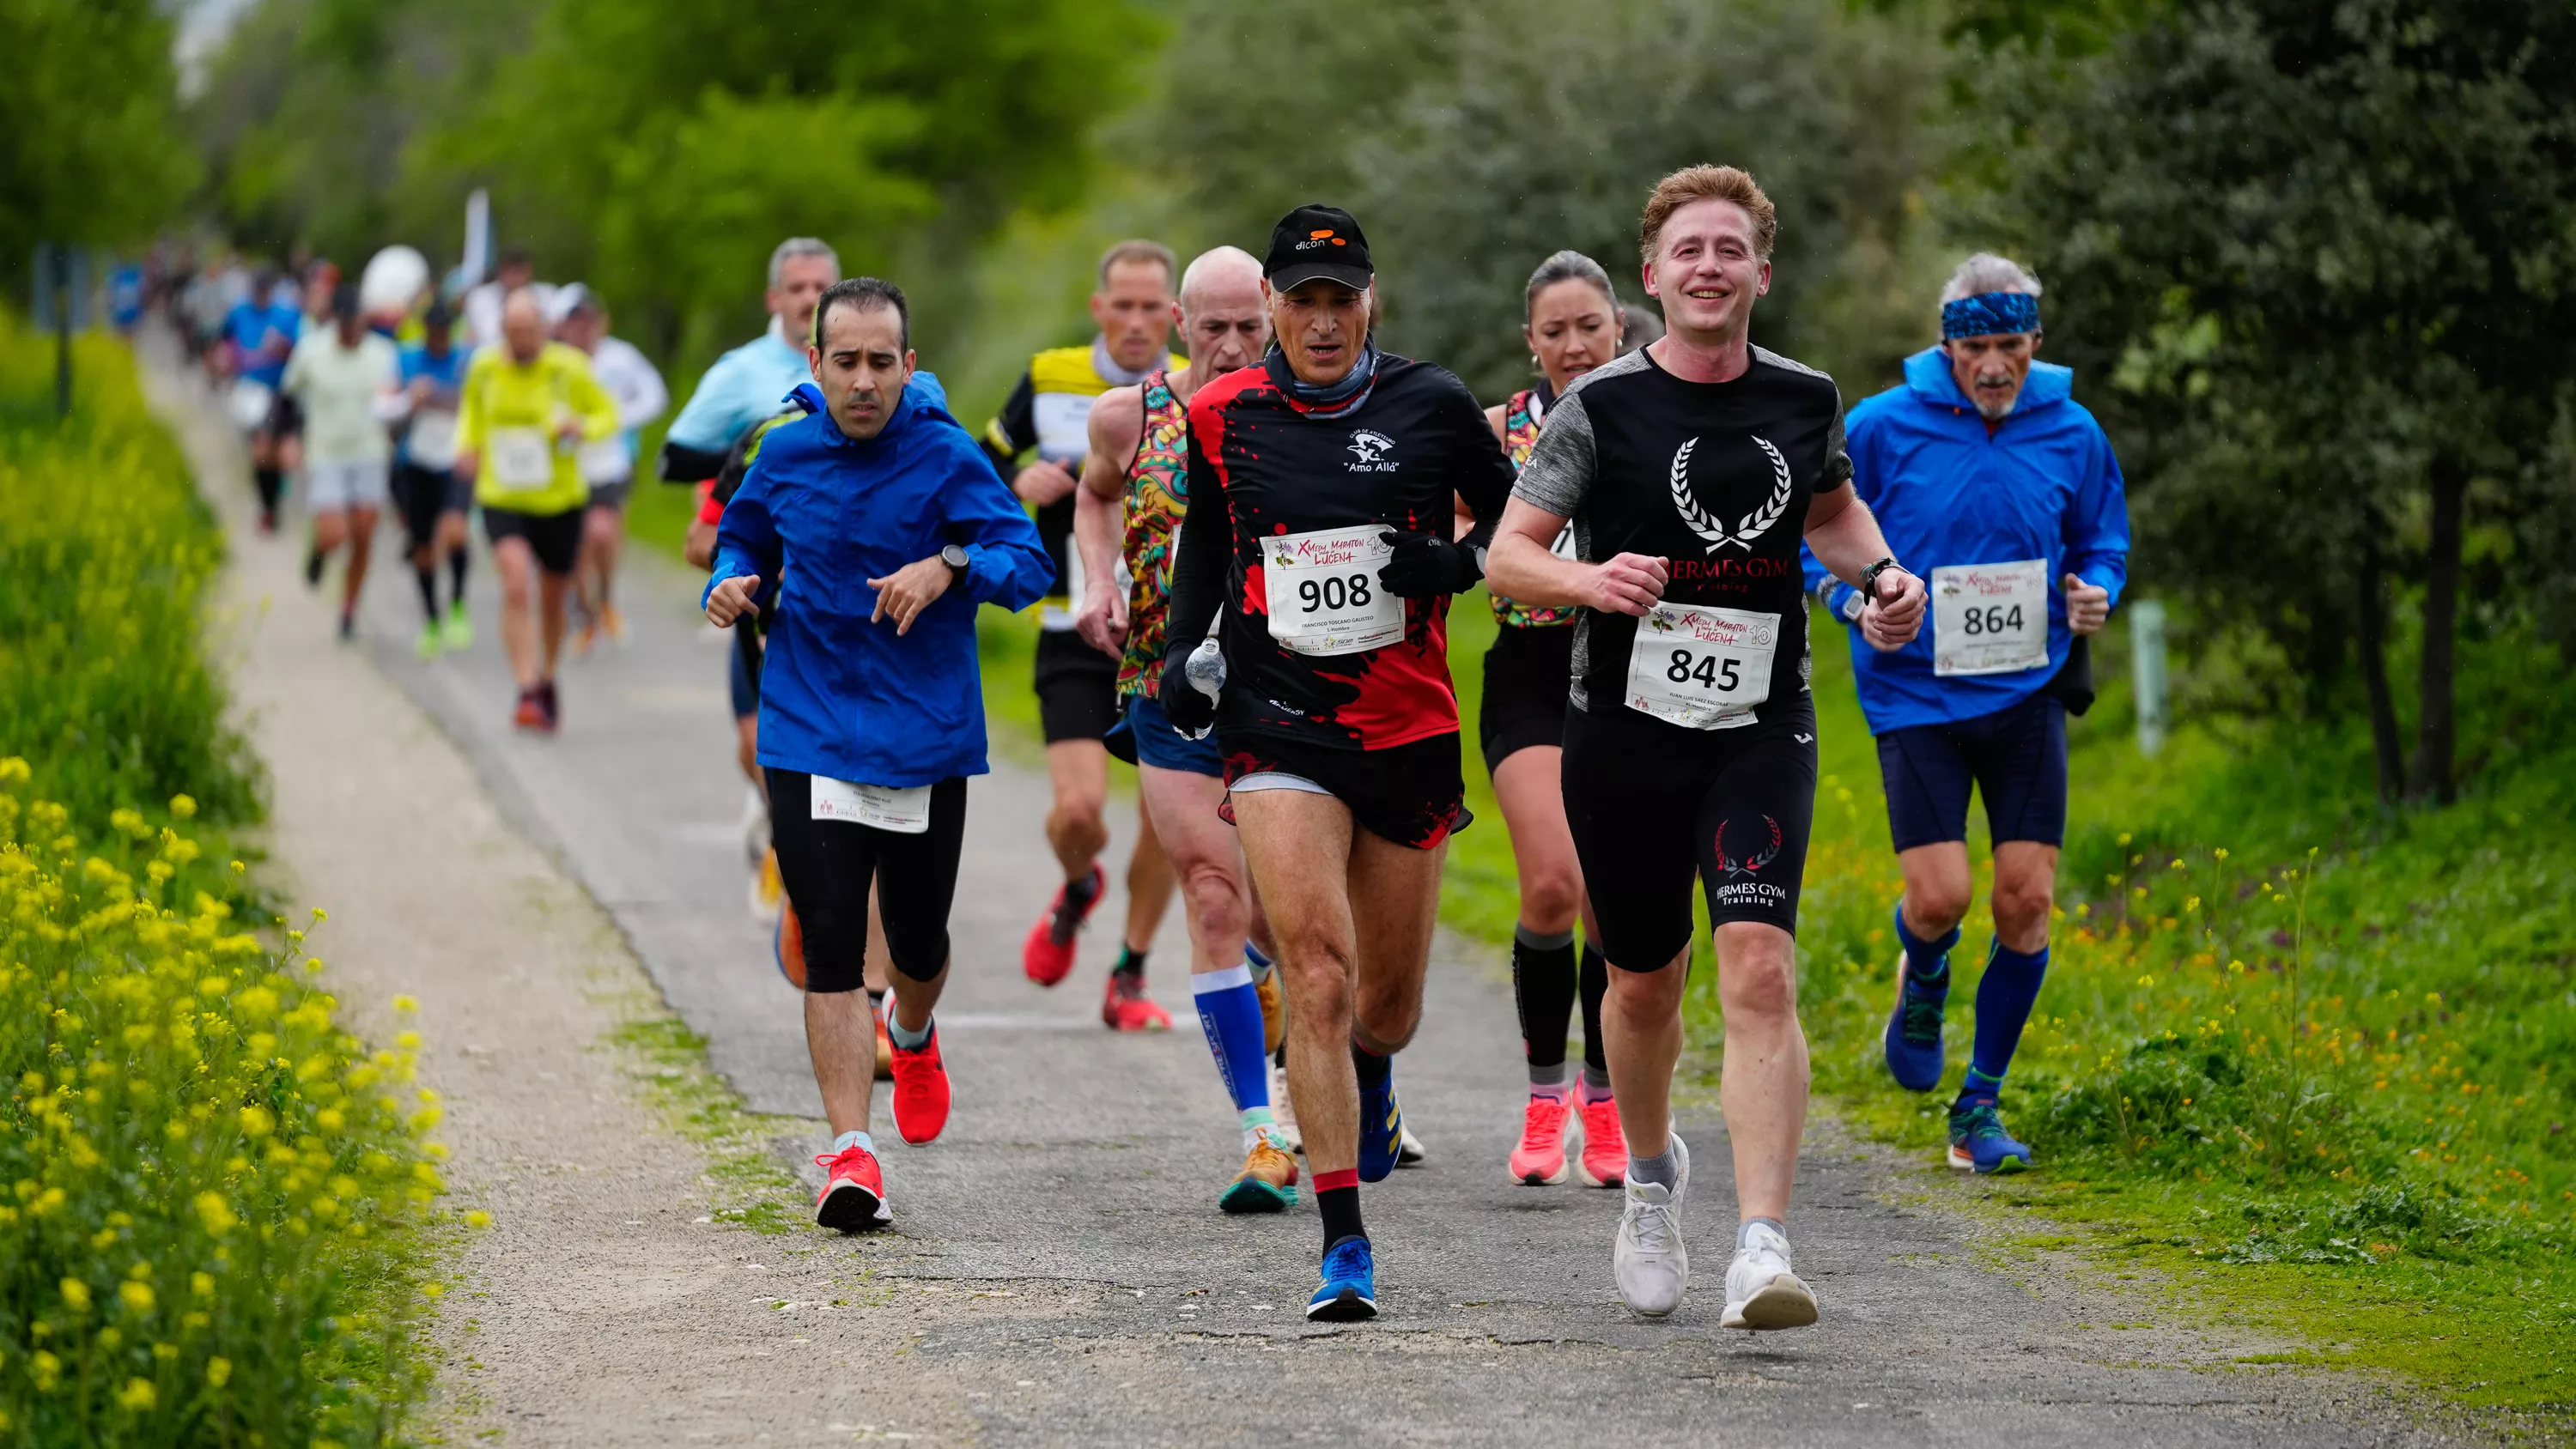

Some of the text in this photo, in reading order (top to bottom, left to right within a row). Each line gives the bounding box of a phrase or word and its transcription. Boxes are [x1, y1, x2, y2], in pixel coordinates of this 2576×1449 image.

[1295, 239, 1325, 250] dicon
[1349, 429, 1361, 439] CLUB
[1370, 430, 1396, 445] ATLETISMO
[1315, 551, 1358, 566] LUCENA
[1746, 558, 1789, 577] GYM
[1298, 573, 1372, 613] 908
[1964, 603, 2025, 635] 864
[1694, 627, 1739, 646] LUCENA
[1667, 649, 1741, 692] 845
[1717, 882, 1786, 900] HERMES GYM
[1722, 894, 1774, 907] Training
